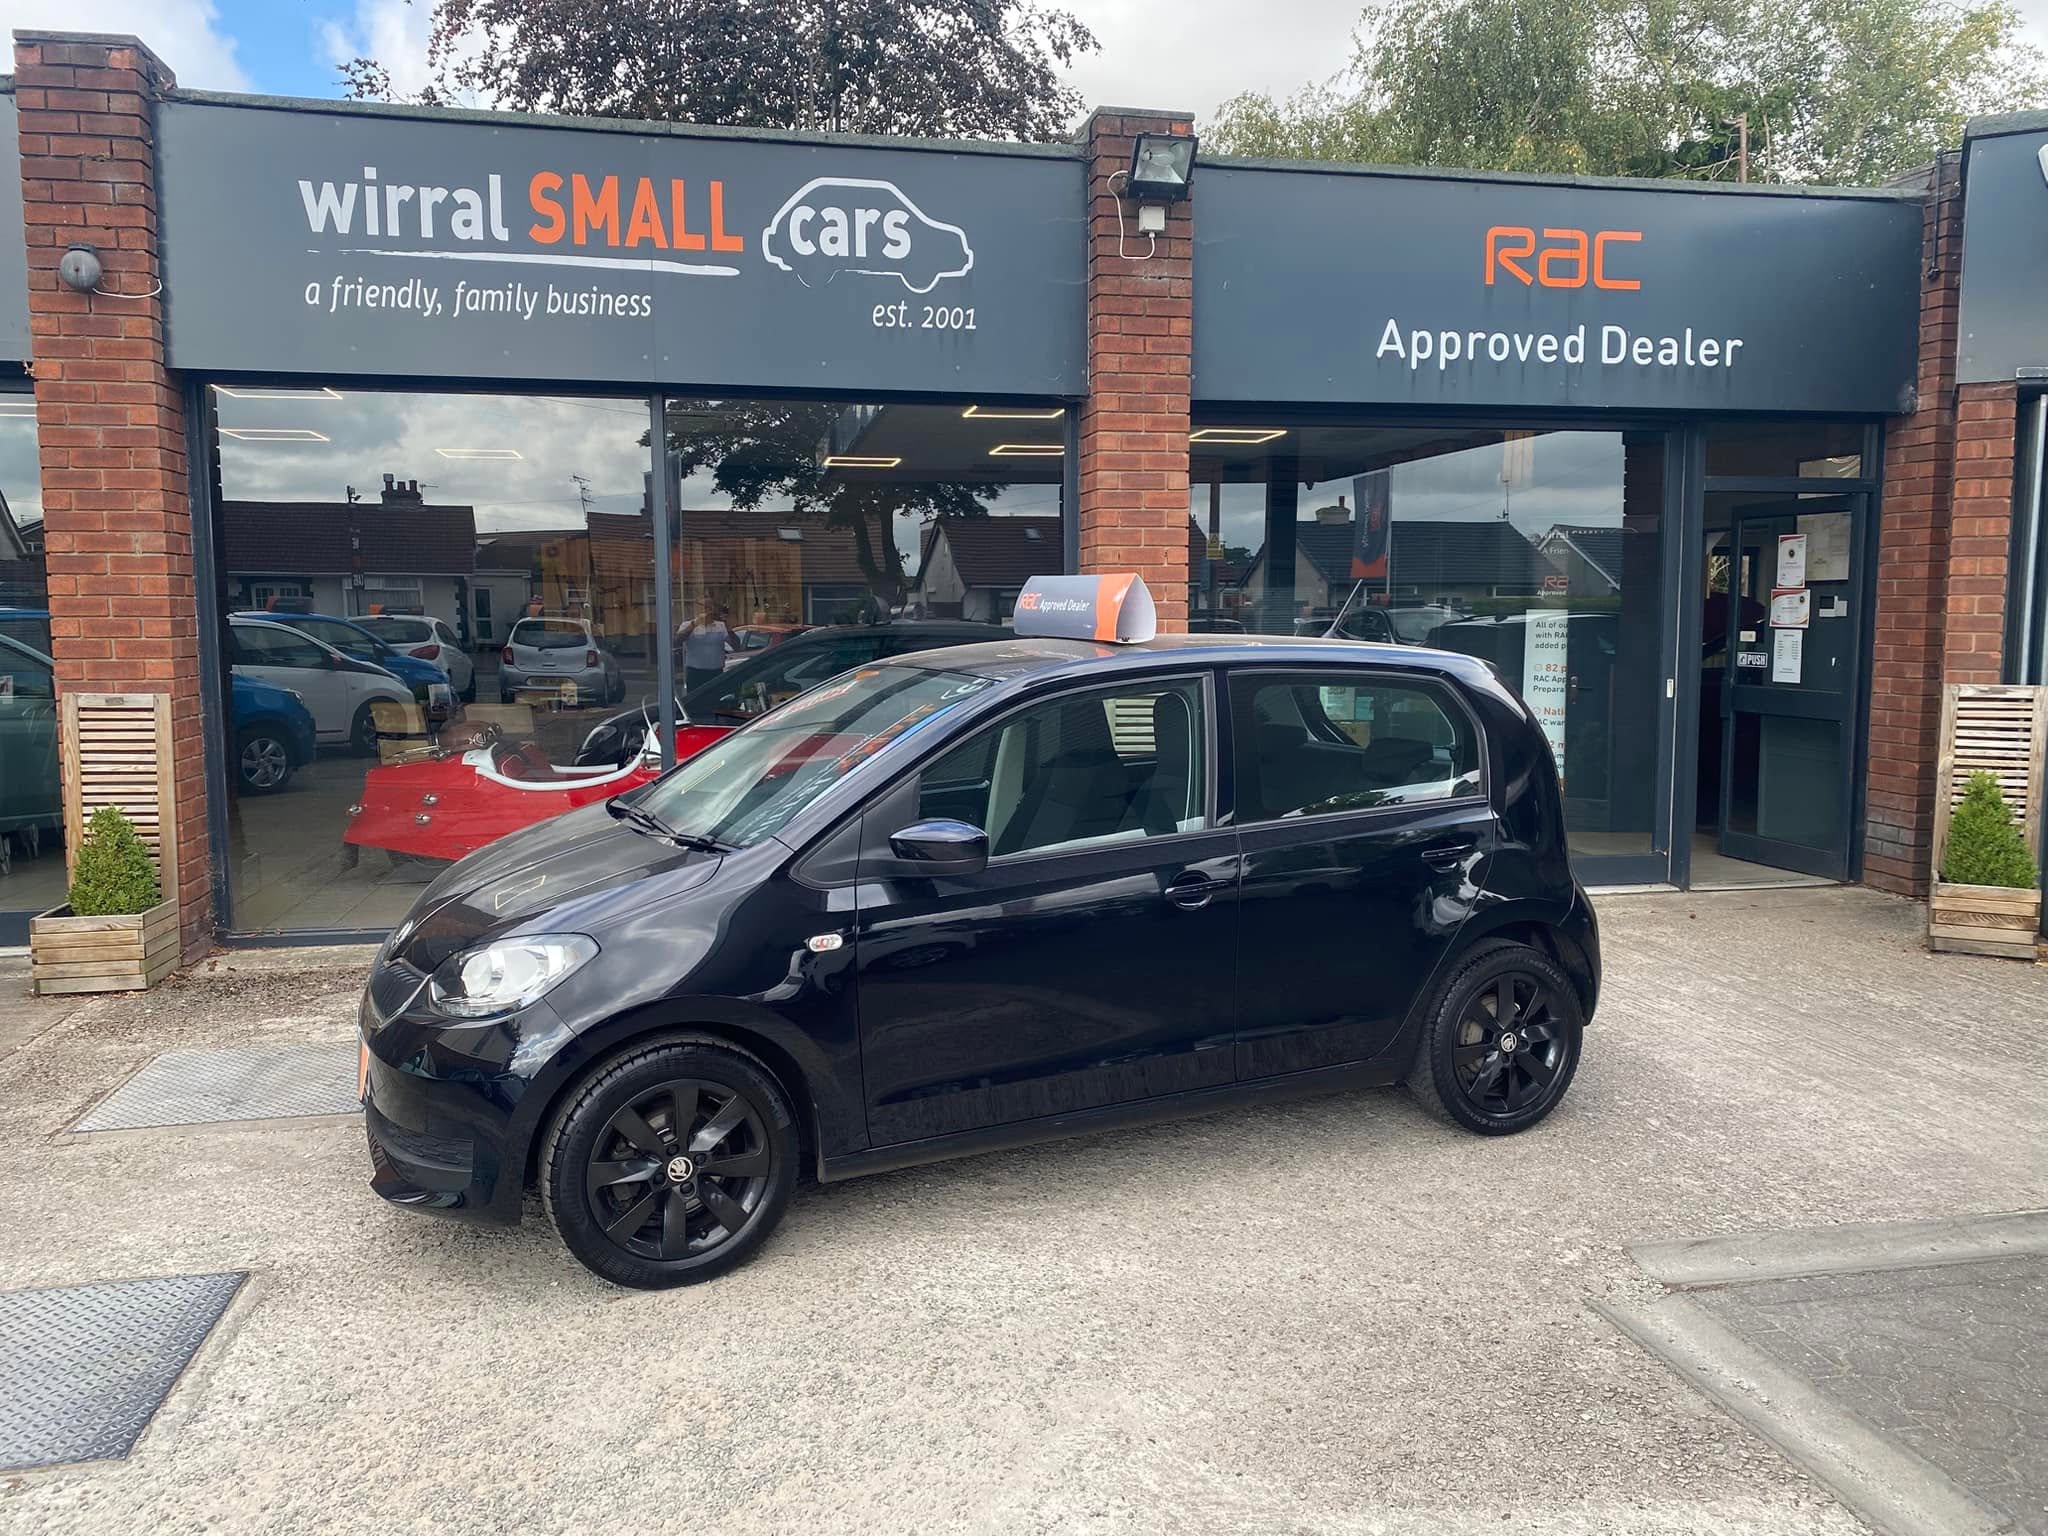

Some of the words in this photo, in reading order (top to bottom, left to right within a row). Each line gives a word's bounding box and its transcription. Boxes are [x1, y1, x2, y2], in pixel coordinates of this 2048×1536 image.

[298, 166, 509, 241] wirral
[529, 171, 744, 253] SMALL
[789, 205, 912, 259] cars
[1485, 226, 1642, 290] RAC
[305, 282, 320, 305] a
[330, 275, 442, 317] friendly,
[453, 280, 539, 321] family
[546, 283, 652, 318] business
[872, 300, 913, 328] est.
[921, 305, 977, 330] 2001
[1376, 318, 1585, 371] Approved
[1601, 325, 1744, 367] Dealer
[1040, 599, 1068, 612] Approved
[1068, 599, 1090, 611] Dealer
[1545, 664, 1558, 672] 82
[1747, 654, 1766, 666] PUSH
